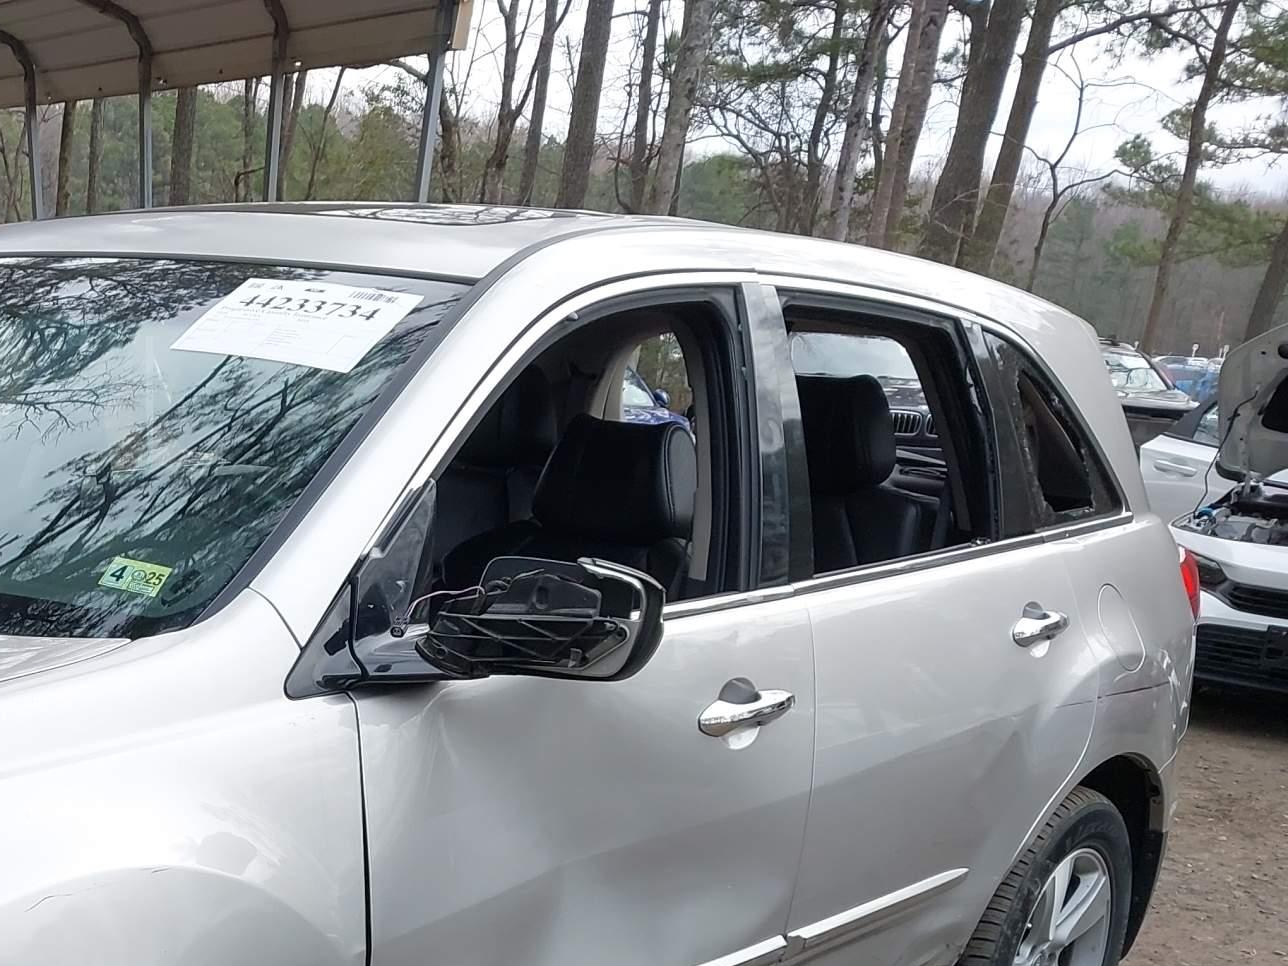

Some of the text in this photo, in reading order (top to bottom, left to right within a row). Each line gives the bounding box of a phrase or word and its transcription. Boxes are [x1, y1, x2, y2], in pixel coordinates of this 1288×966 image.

[240, 295, 381, 321] 44233734
[110, 565, 165, 586] 4 25
